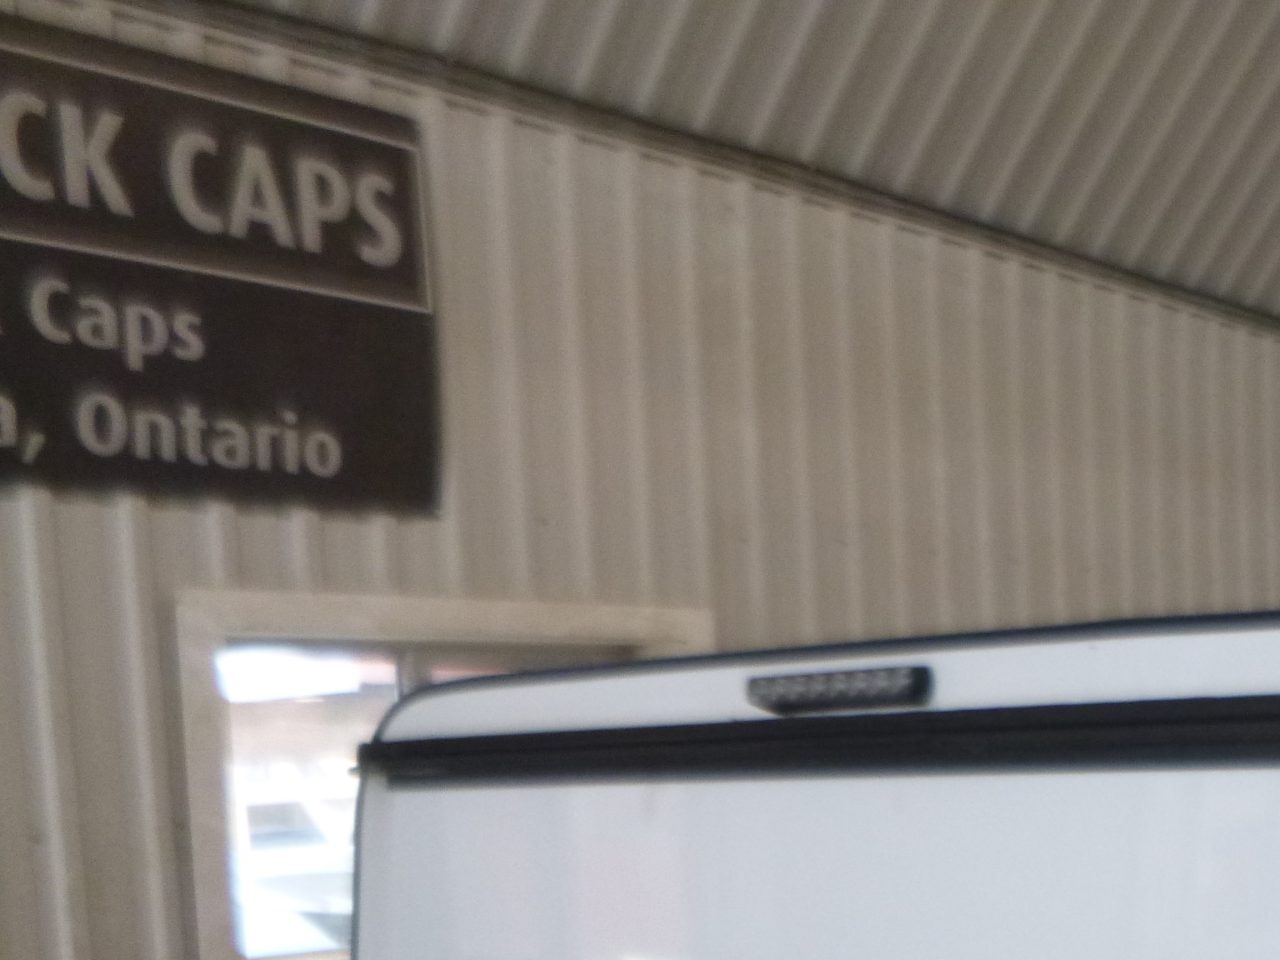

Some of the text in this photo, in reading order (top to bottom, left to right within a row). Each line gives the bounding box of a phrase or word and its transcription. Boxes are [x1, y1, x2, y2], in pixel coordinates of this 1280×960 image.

[0, 92, 403, 268] CK CAPS
[29, 277, 207, 372] Caps
[76, 392, 342, 478] Ontario
